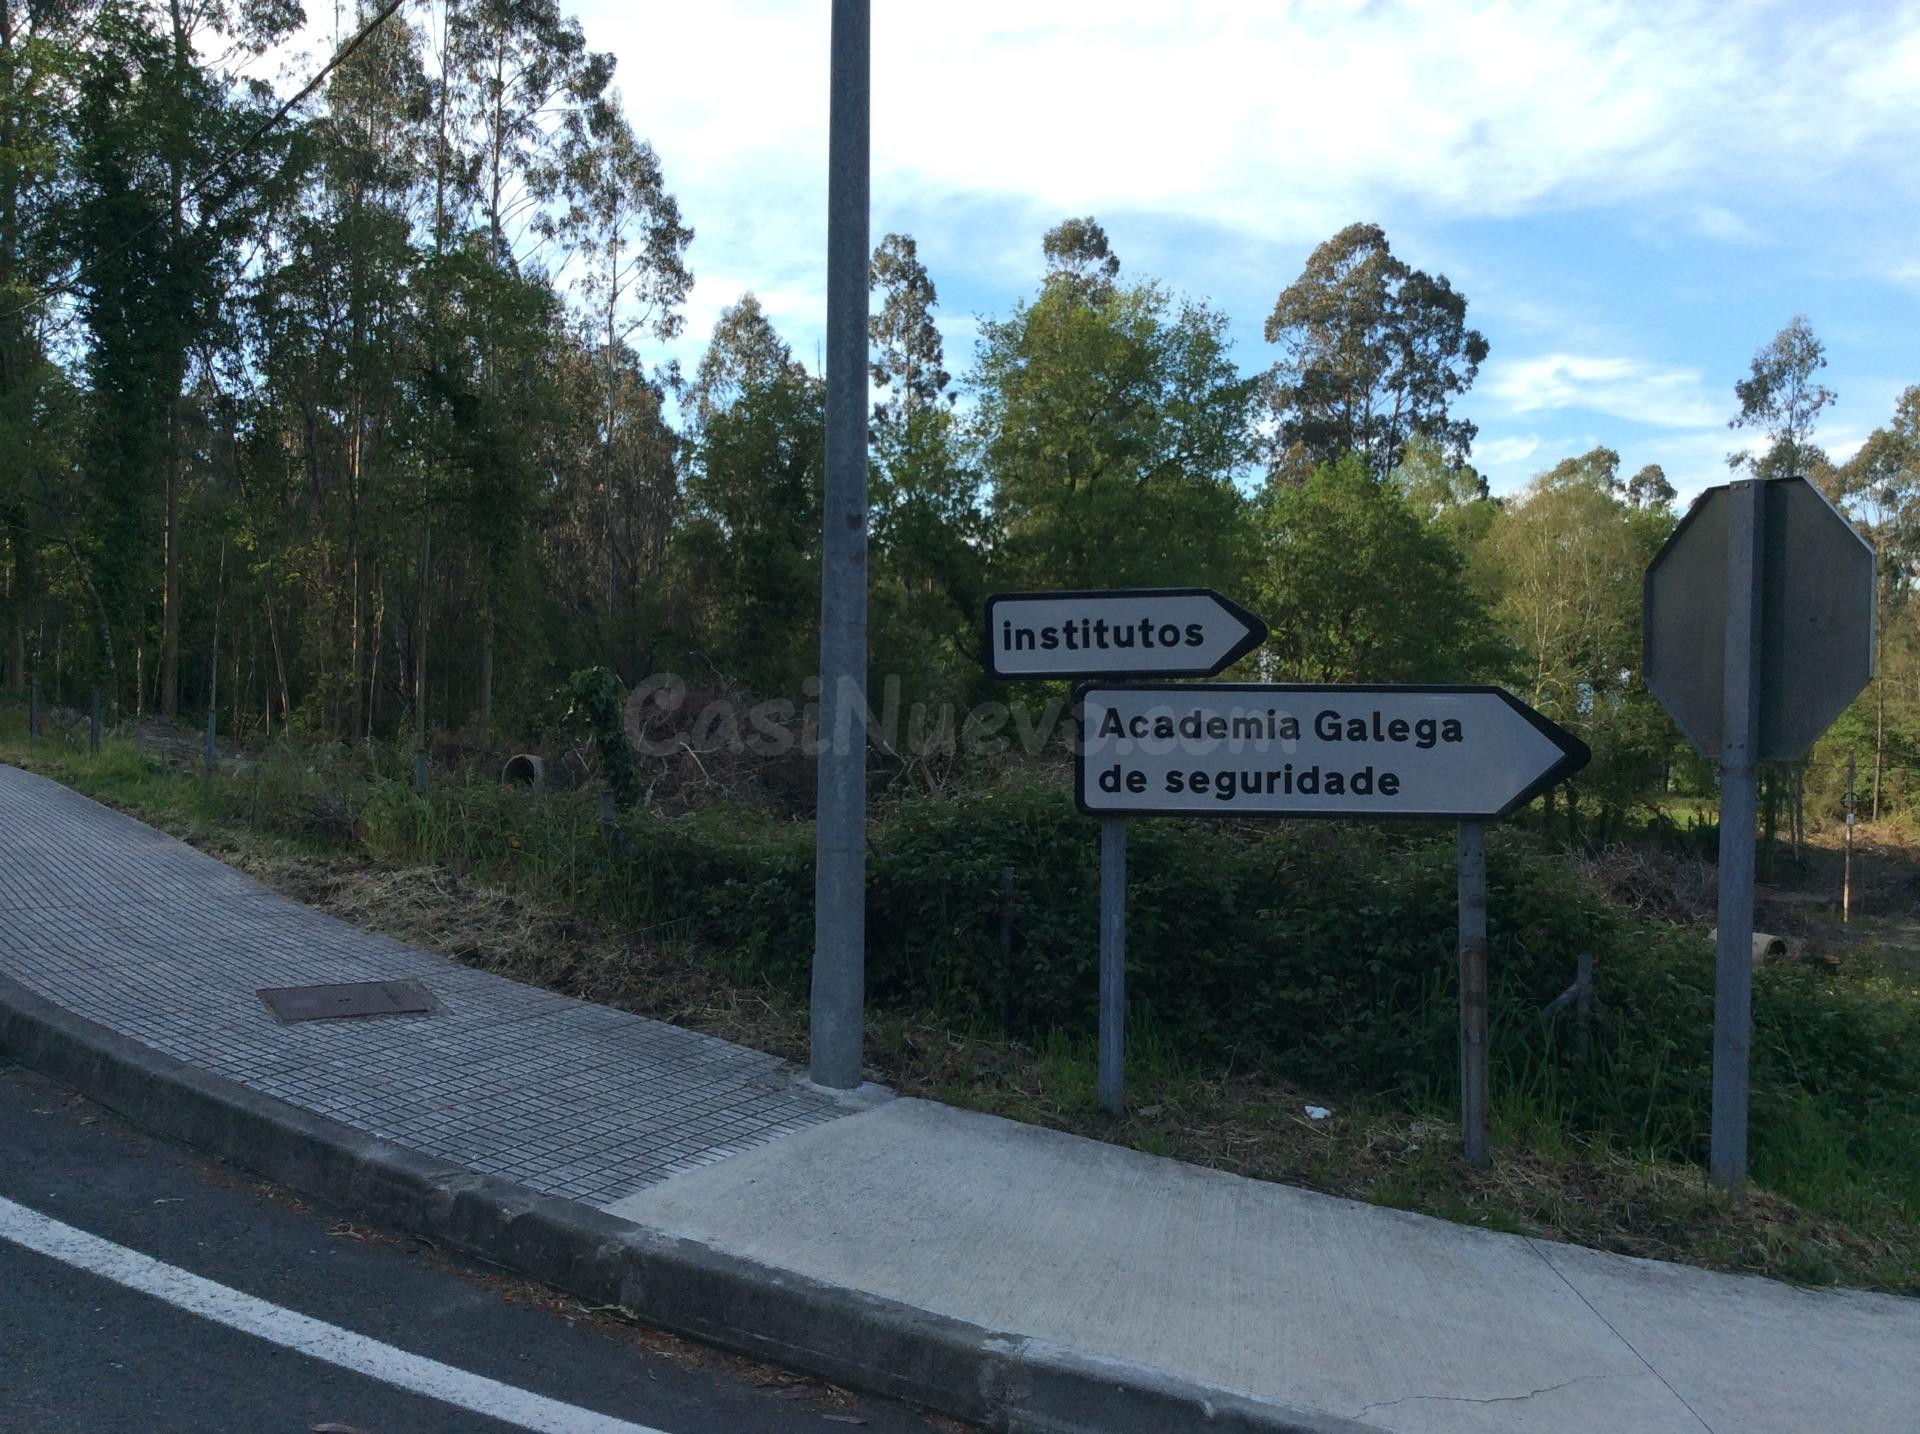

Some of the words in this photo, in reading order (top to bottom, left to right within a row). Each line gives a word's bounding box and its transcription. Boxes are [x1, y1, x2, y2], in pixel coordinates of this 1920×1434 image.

[1002, 617, 1205, 651] institutos
[1098, 707, 1300, 741] Academia
[1314, 709, 1464, 749] Galega
[1099, 764, 1147, 794] de
[1165, 764, 1401, 801] seguridade
